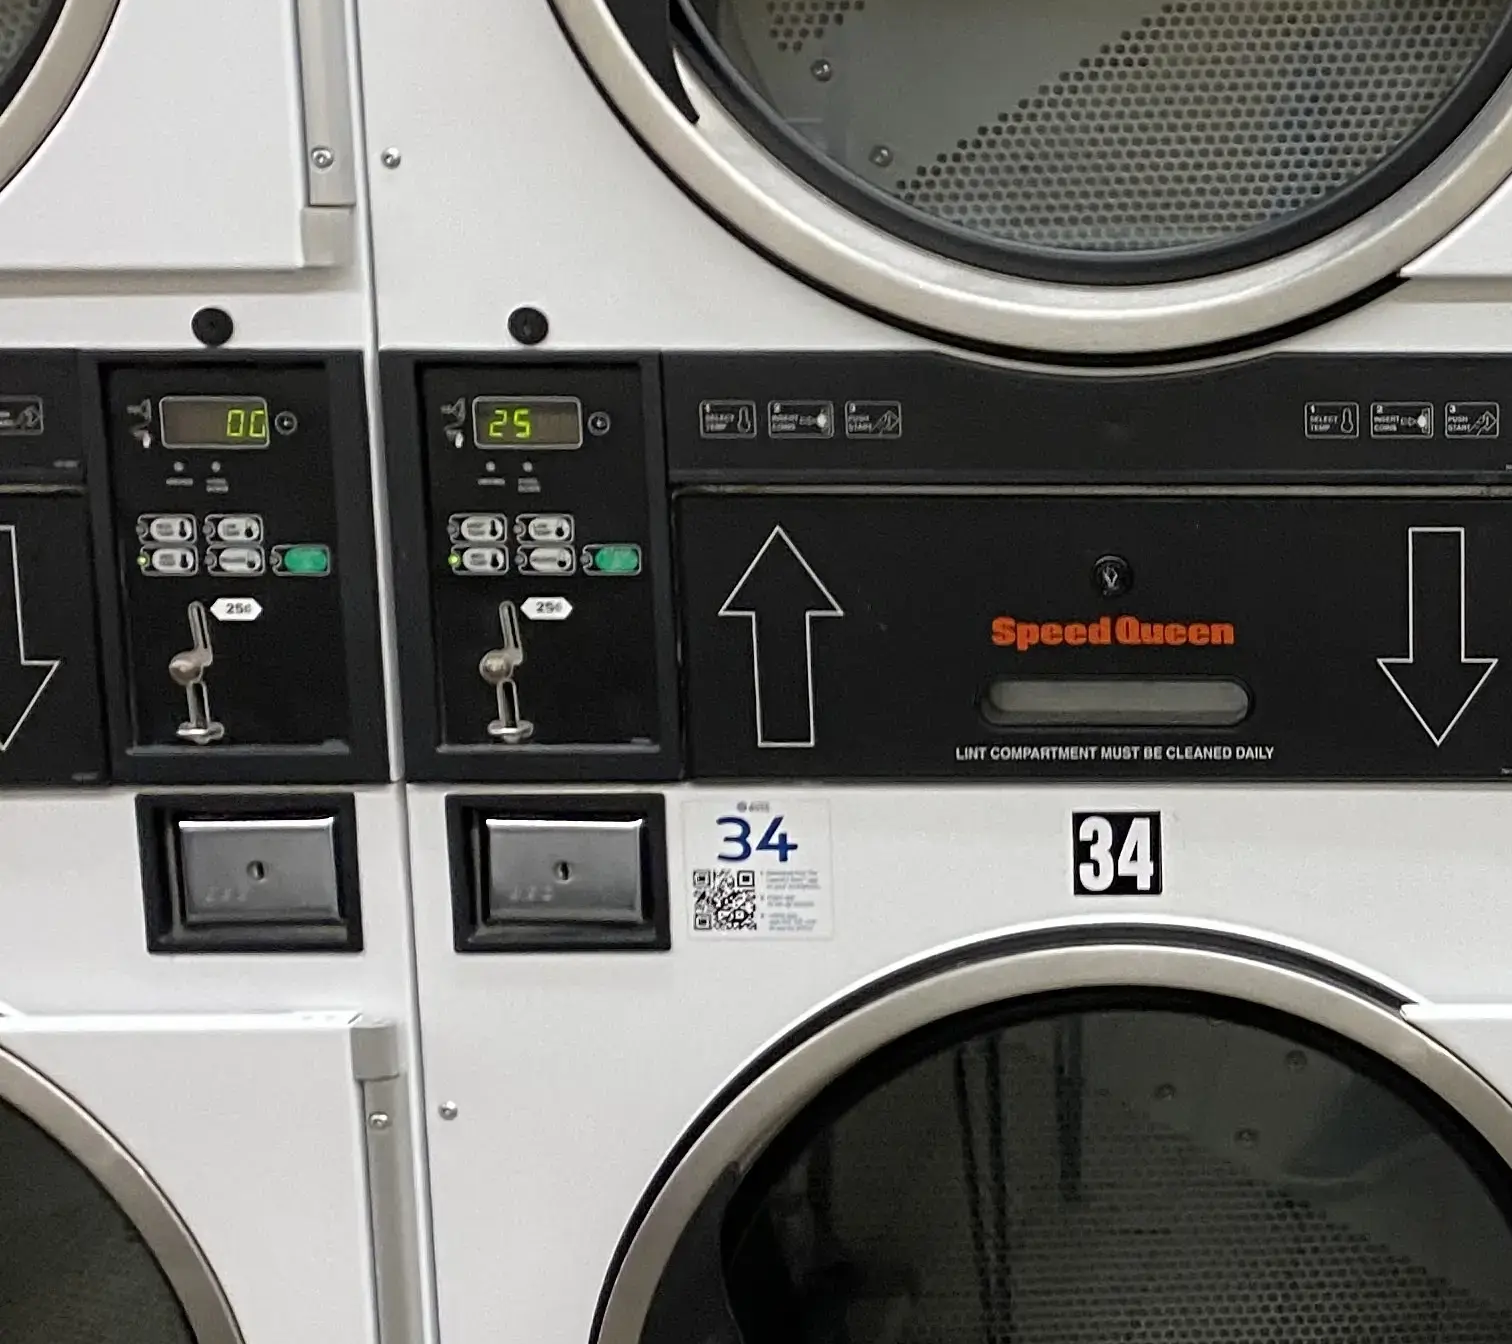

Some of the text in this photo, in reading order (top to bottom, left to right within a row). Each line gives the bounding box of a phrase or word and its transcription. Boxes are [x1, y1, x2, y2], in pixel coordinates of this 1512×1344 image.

[488, 409, 532, 438] 25
[991, 615, 1234, 651] Speed Queen
[955, 745, 1274, 761] LINT COMPARTMENT MUST BE CLEANED DAILY
[716, 816, 798, 862] 34
[1077, 815, 1154, 892] 34
